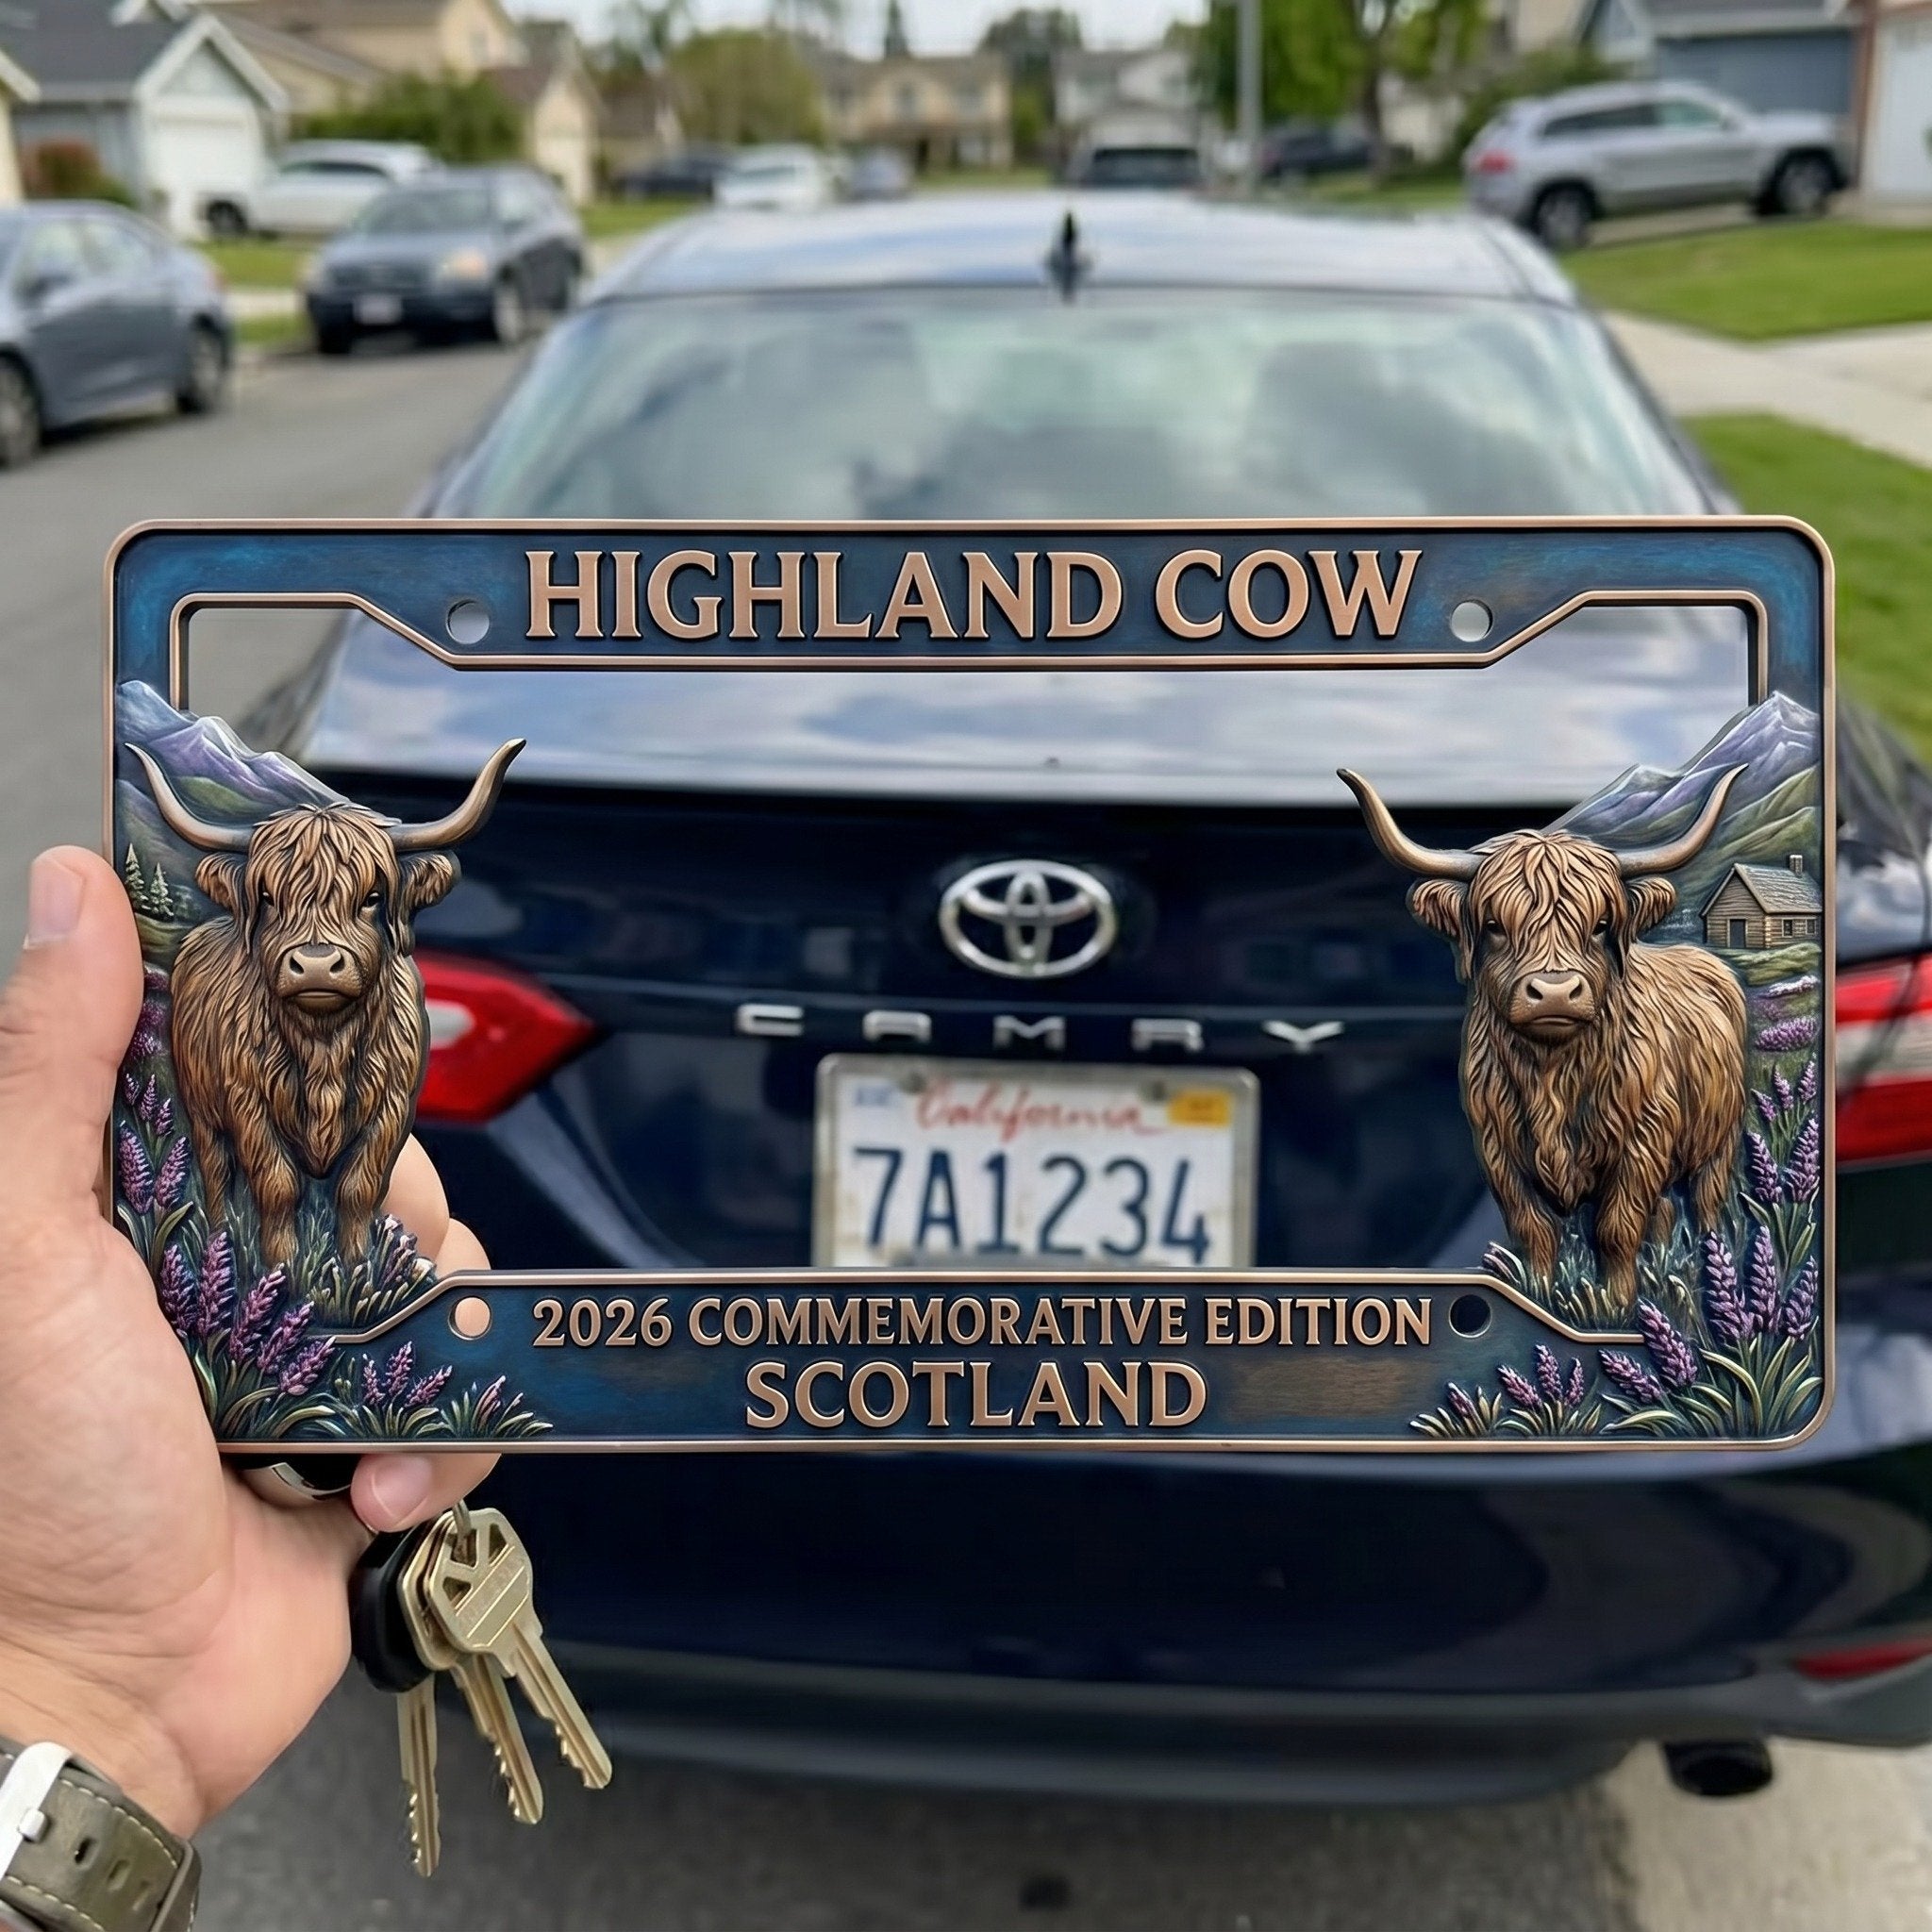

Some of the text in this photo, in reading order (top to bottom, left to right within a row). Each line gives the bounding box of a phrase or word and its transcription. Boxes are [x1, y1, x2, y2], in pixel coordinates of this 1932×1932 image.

[525, 548, 1424, 640] HIGHLAND COW
[736, 1004, 1344, 1052] CAMRY
[915, 1079, 1164, 1142] California
[853, 1145, 1211, 1265] 7A1234
[531, 1297, 1432, 1347] 2026 COMMEMORATIVE EDITION
[745, 1360, 1208, 1428] SCOTLAND
